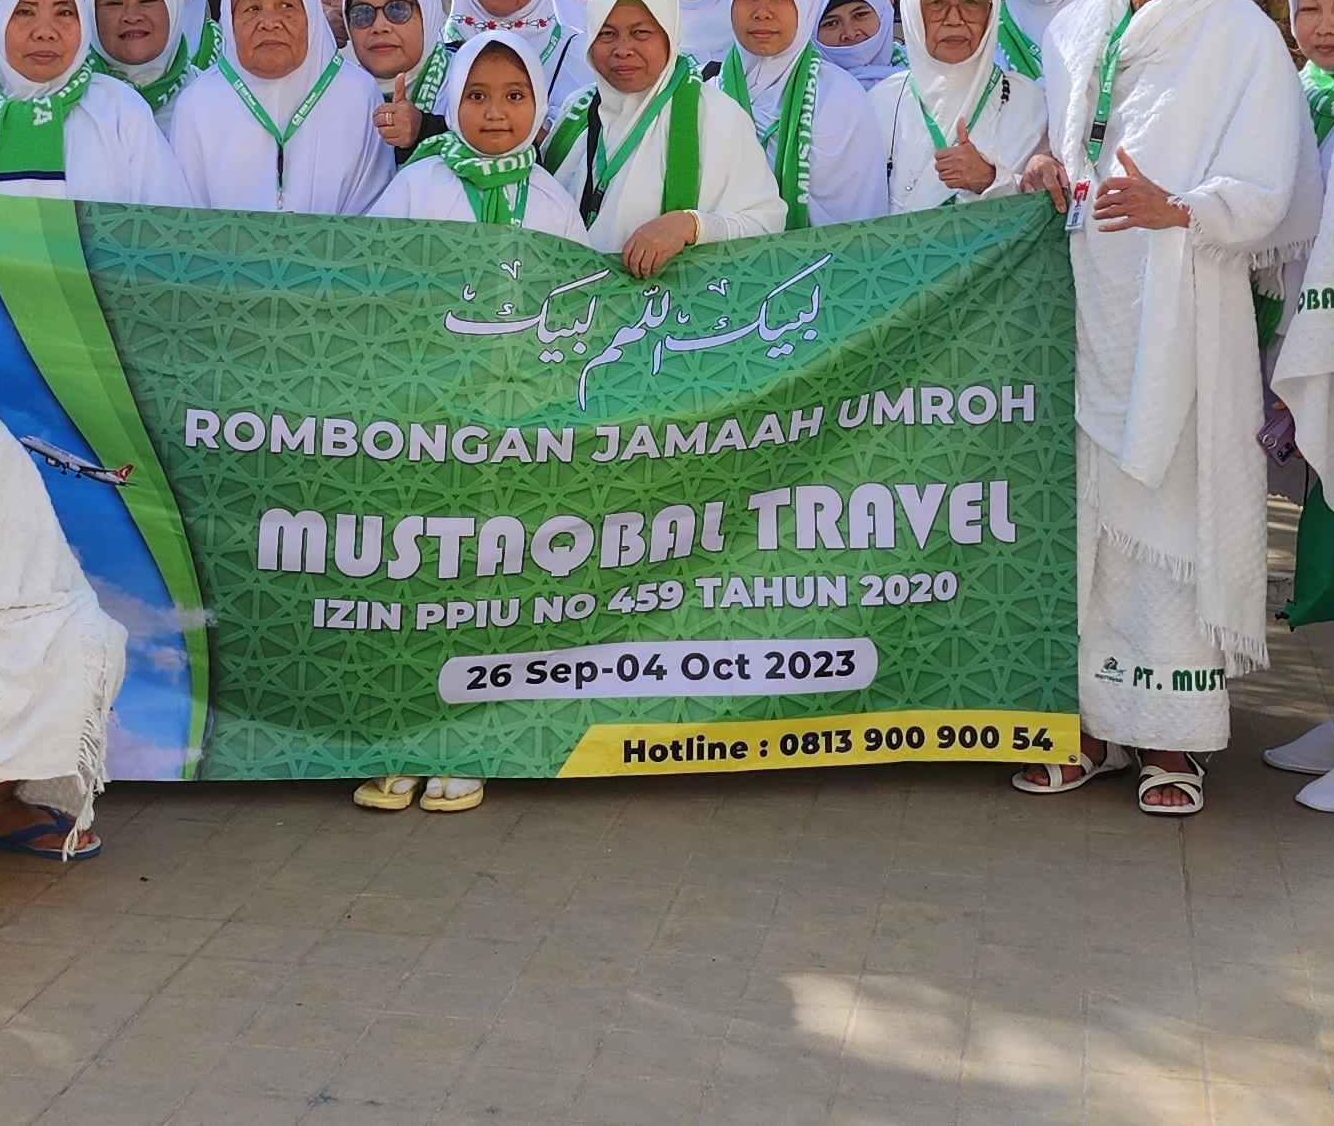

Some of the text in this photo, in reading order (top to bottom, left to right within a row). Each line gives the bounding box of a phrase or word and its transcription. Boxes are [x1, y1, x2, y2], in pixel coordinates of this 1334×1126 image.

[184, 384, 1036, 464] ROMBONGAN JAMAAH UMROH
[257, 480, 1017, 580] MUSTAQBAL TRAVEL
[312, 571, 959, 632] IZIN PPIU NO 459 TAHUN 2020
[467, 650, 857, 690] 26 Sep-04 Oct 2023
[1133, 666, 1163, 690] PT.
[1172, 668, 1227, 692] MUST
[623, 734, 749, 764] Hotline
[779, 730, 854, 756] 0813
[864, 726, 927, 752] 900
[936, 725, 1001, 750] 900
[1011, 726, 1055, 753] 54
